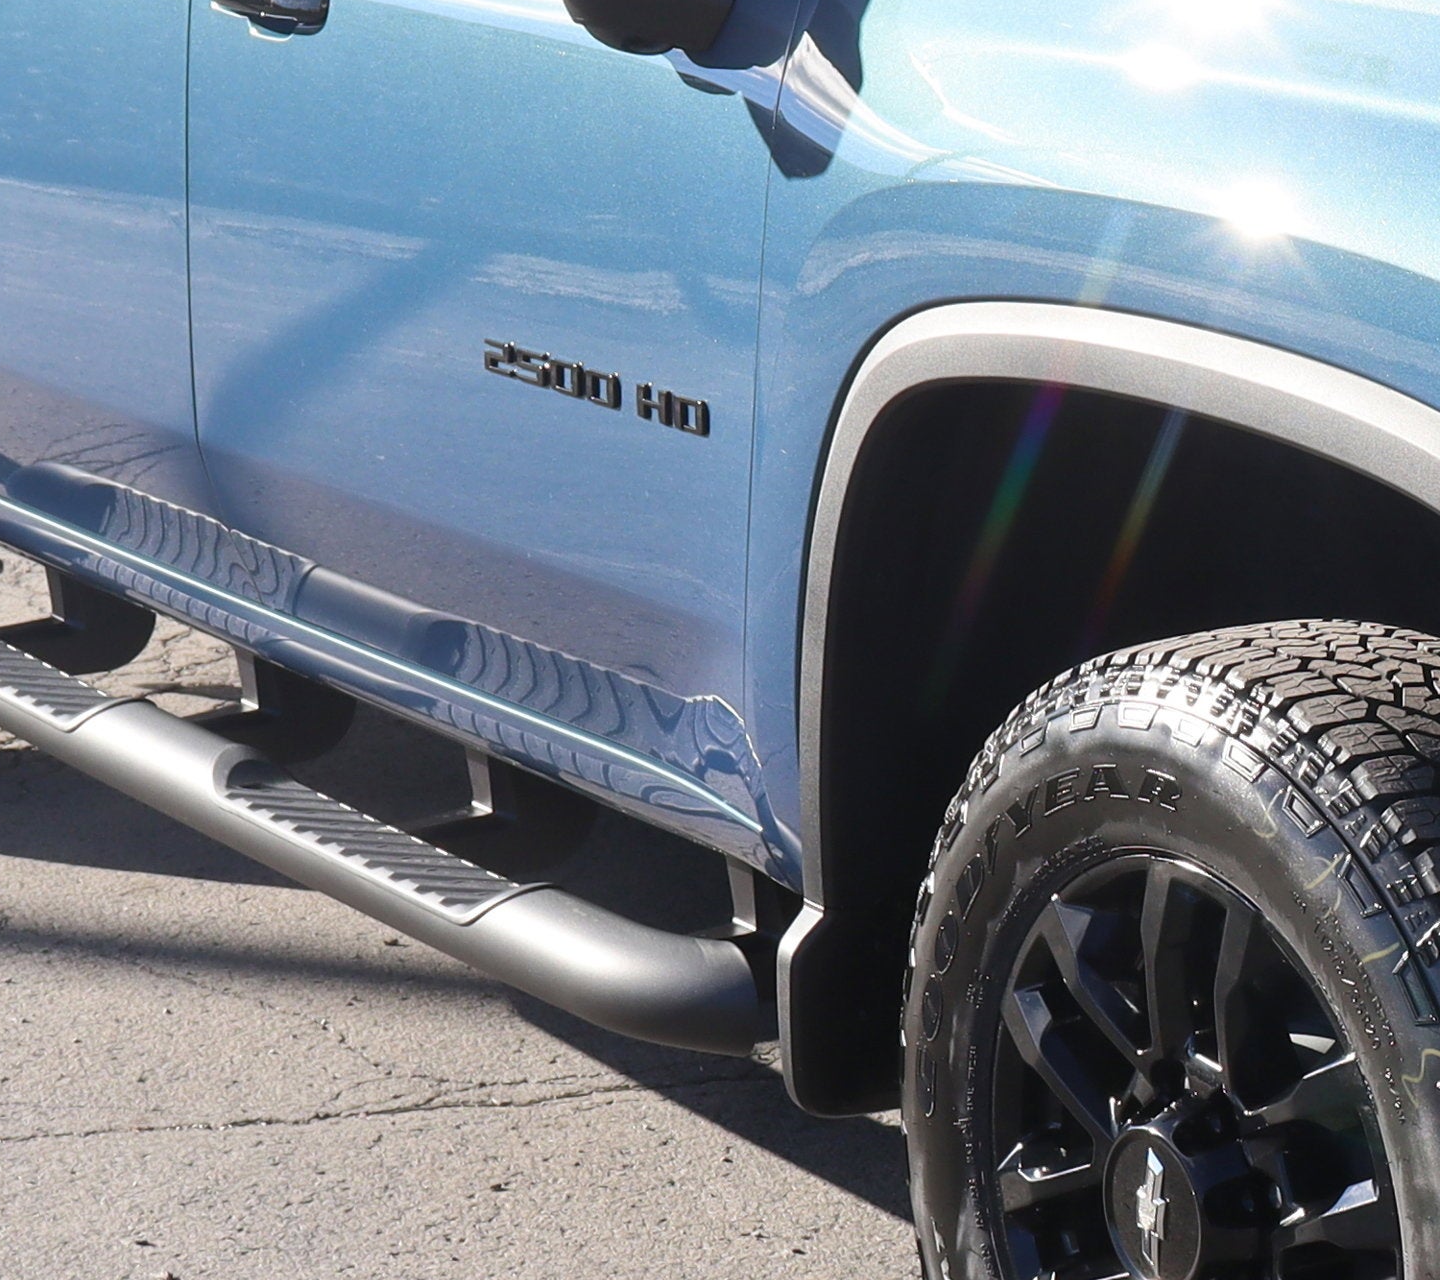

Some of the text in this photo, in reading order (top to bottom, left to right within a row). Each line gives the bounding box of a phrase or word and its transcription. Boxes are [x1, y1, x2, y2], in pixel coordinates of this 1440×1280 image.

[483, 337, 711, 438] 2500 HD
[914, 762, 1185, 1118] GOODYEAR
